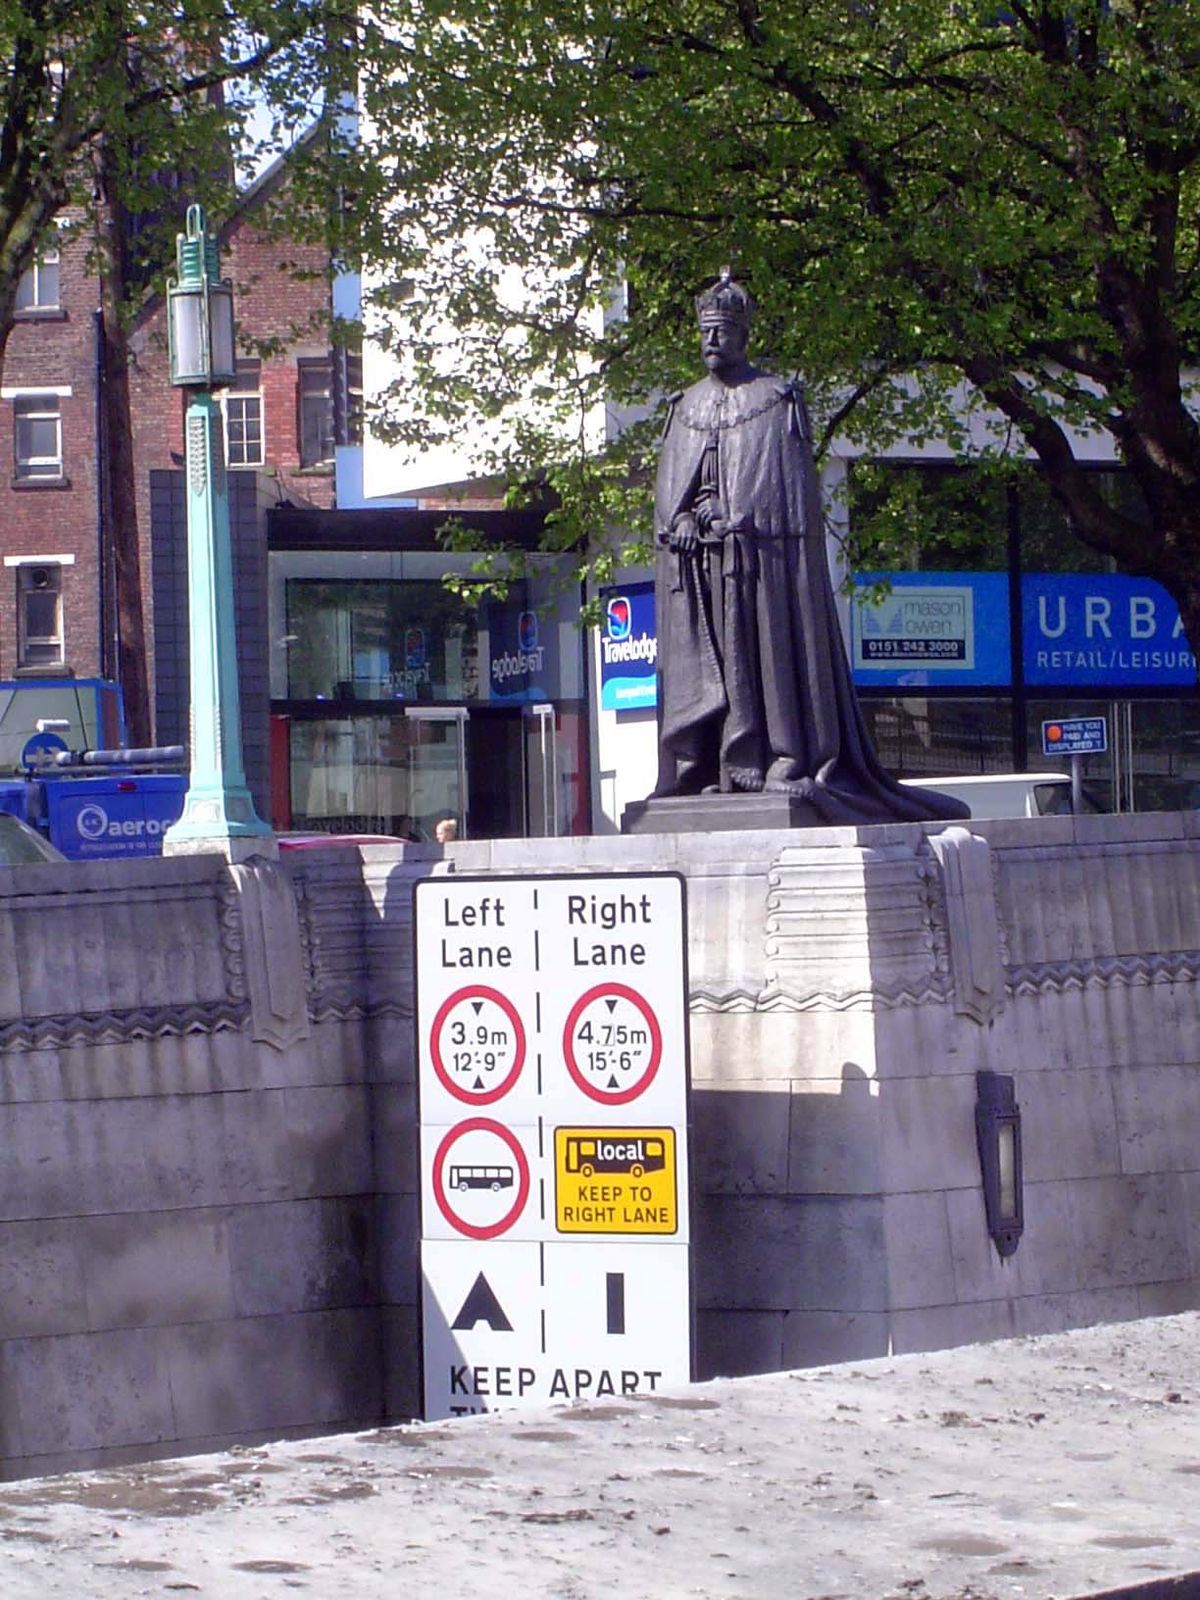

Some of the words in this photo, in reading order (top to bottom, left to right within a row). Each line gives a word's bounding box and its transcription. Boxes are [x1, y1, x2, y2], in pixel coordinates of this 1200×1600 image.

[904, 602, 961, 617] mason
[905, 620, 952, 634] owen
[869, 641, 898, 652] 0151
[902, 641, 926, 652] 242
[928, 641, 959, 652] 3000
[1083, 731, 1101, 739] AND
[444, 898, 505, 927] Left
[568, 894, 651, 929] Right
[441, 939, 512, 967] Lane
[573, 937, 646, 966] Lane
[451, 1022, 507, 1045] 3.9m
[577, 1021, 647, 1045] 4.75m
[597, 1140, 645, 1160] local
[578, 1186, 623, 1201] KEEP
[631, 1186, 652, 1202] TO
[563, 1207, 616, 1222] RIGHT
[623, 1207, 669, 1223] LANE
[450, 1365, 536, 1396] KEEP
[549, 1368, 662, 1398] APART
